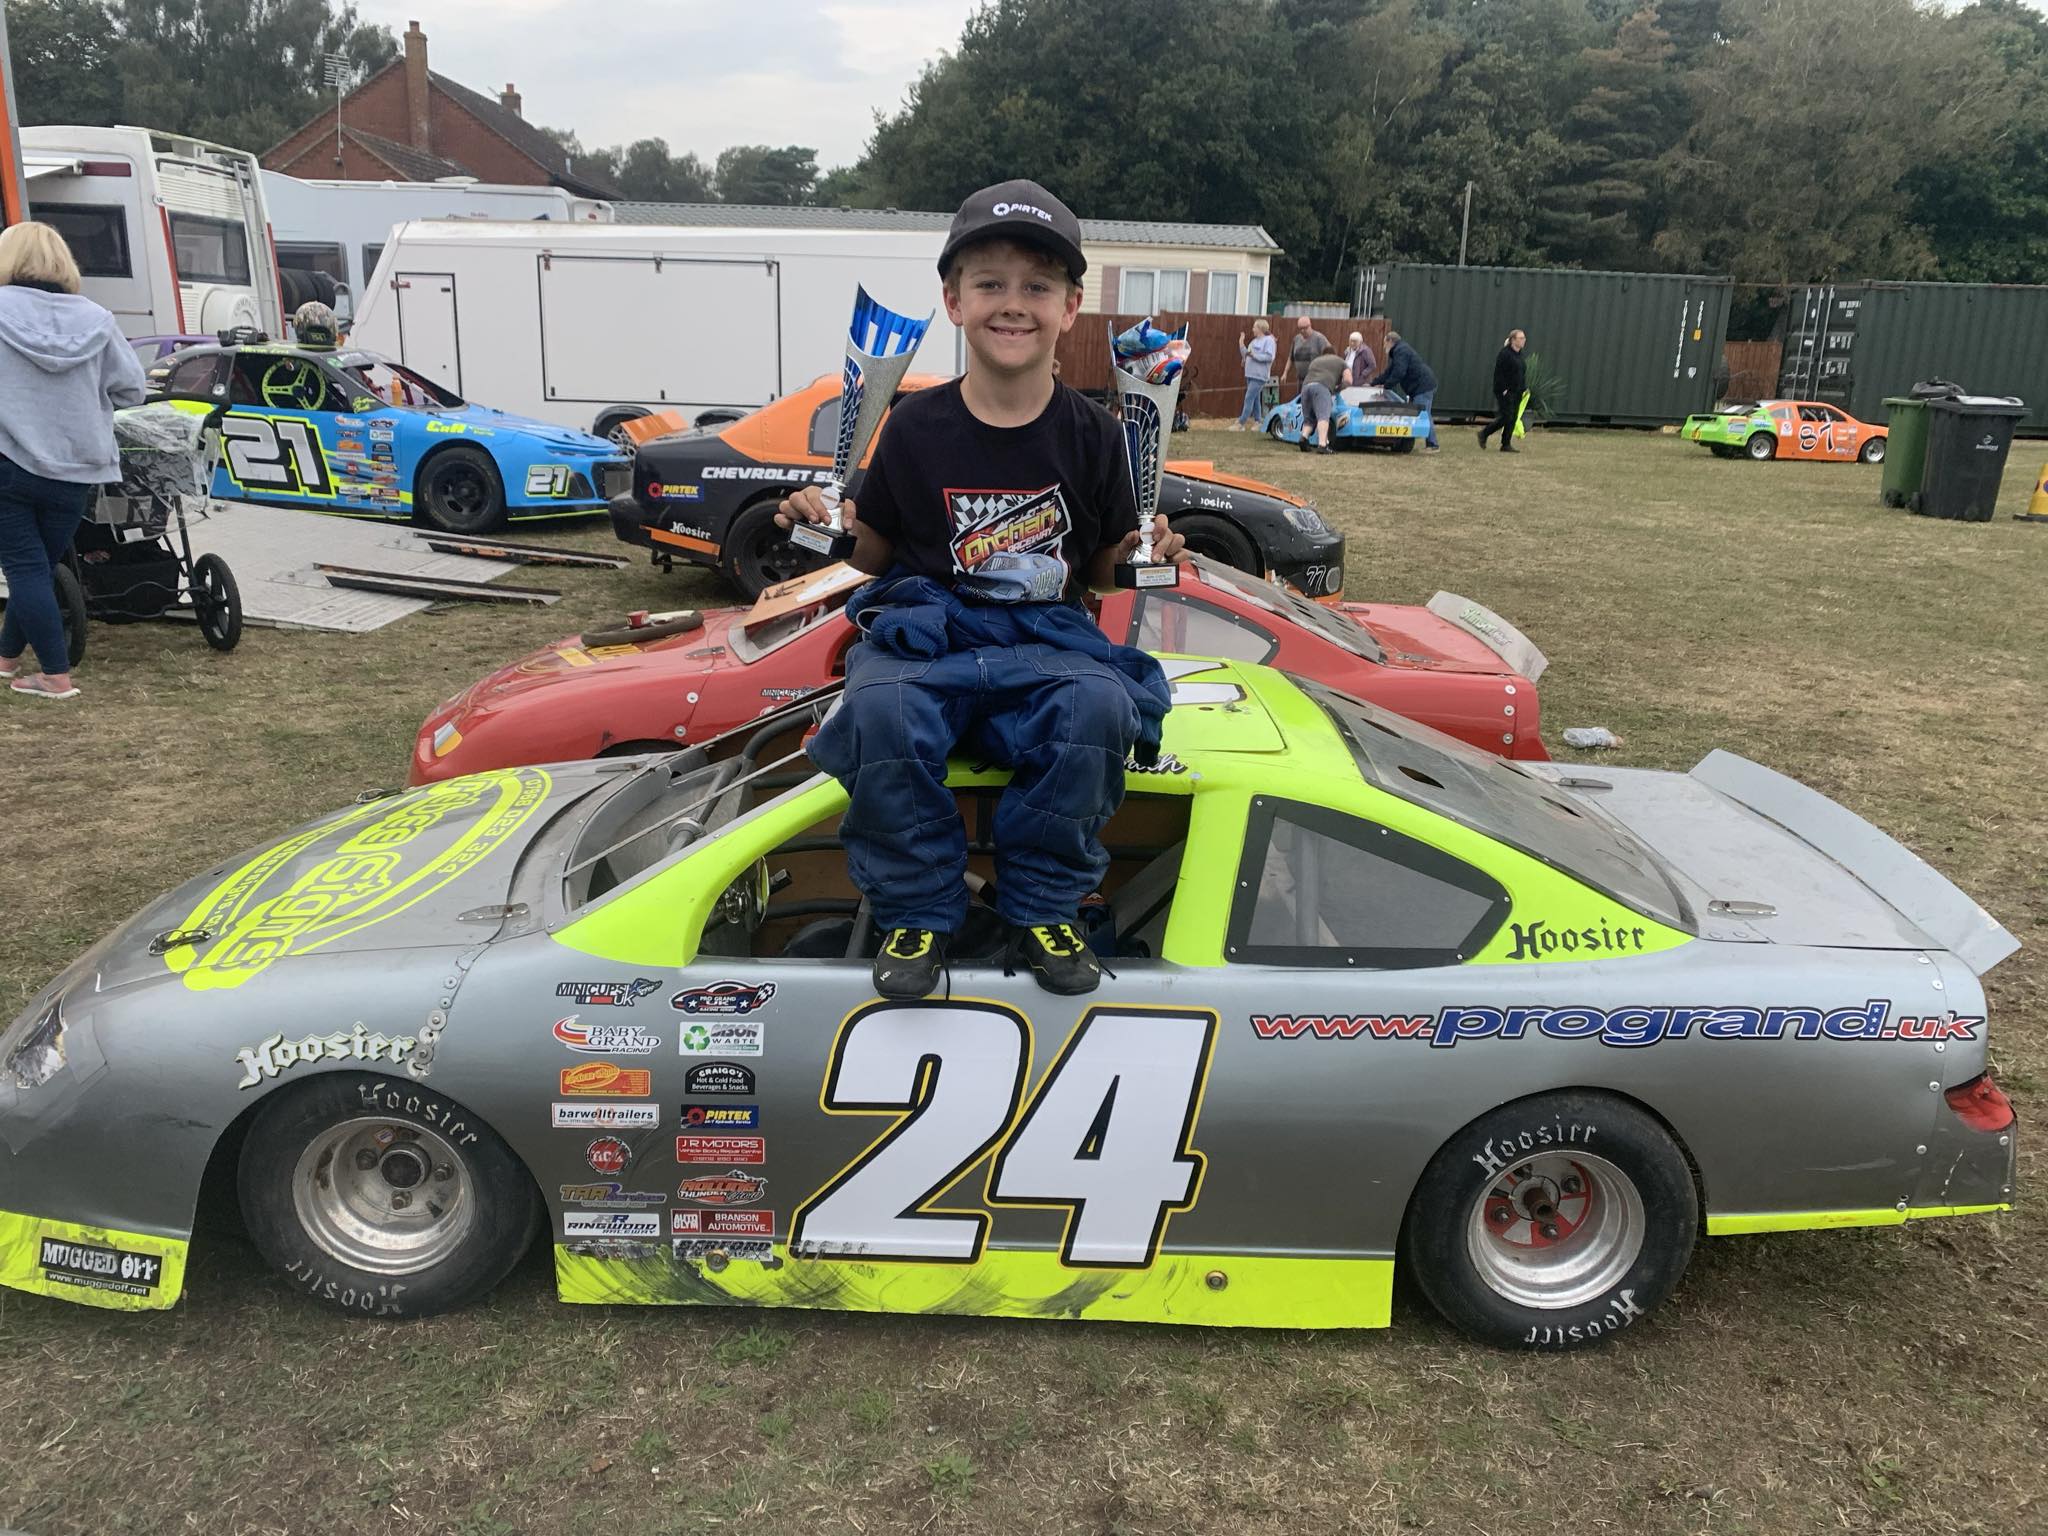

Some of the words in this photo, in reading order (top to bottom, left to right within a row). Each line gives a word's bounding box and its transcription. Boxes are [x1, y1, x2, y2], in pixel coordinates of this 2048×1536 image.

[1010, 203, 1052, 222] PIRTEK
[221, 414, 333, 495] 21
[701, 466, 808, 481] CHEVROLET
[528, 466, 569, 496] 21
[662, 485, 699, 495] PIRTEK
[671, 521, 712, 540] Hoosier
[1007, 526, 1054, 554] RACEWAY
[484, 809, 524, 837] 023
[437, 842, 490, 874] 324
[1507, 918, 1646, 960] Hoosier
[612, 995, 635, 1007] UK
[1250, 999, 1985, 1047] www.progrand.uk
[592, 1026, 645, 1037] BABY
[588, 1035, 661, 1048] GRAND
[235, 1020, 418, 1090] Hoosier
[691, 1084, 721, 1092] Beverages
[559, 1108, 654, 1120] barwelltrailers
[705, 1110, 752, 1121] PIRTEK
[788, 996, 1221, 1271] 24
[689, 1140, 700, 1148] R
[702, 1140, 759, 1149] MOTORS
[1473, 1112, 1599, 1181] Hoosier
[680, 1182, 757, 1193] ROLLING
[679, 1191, 727, 1199] THUNDER
[673, 1214, 698, 1222] AUTO
[673, 1219, 698, 1230] GLYM
[714, 1213, 759, 1223] BRANSON
[567, 1222, 657, 1230] RINGWOOD
[707, 1222, 766, 1232] AUTOMOTIVE
[42, 1242, 118, 1275] MUGGED
[48, 1272, 147, 1296] www.muggedoff.net
